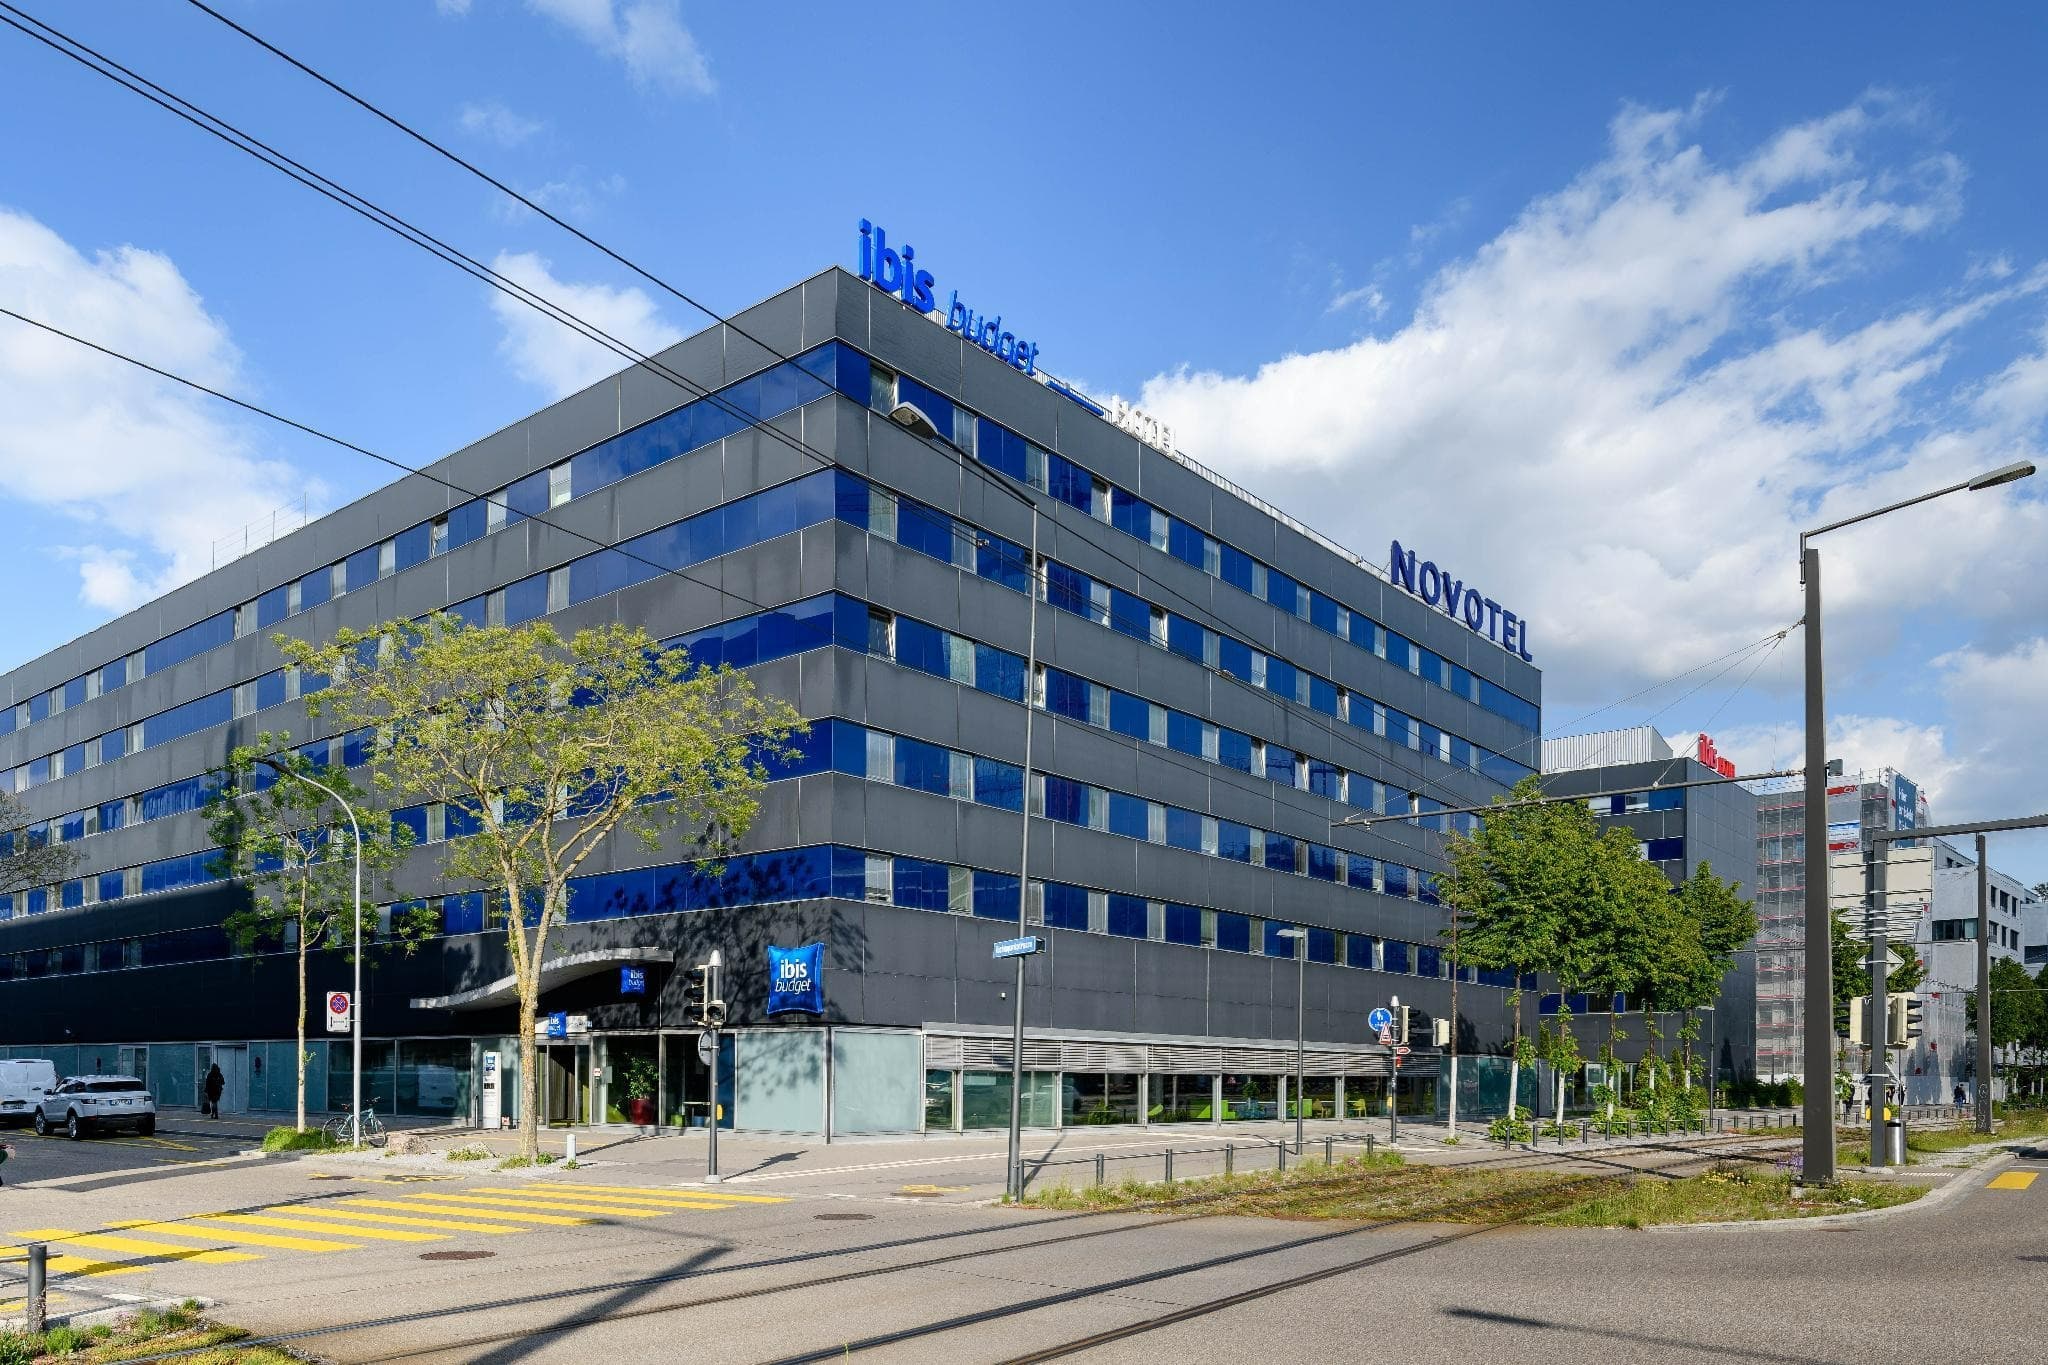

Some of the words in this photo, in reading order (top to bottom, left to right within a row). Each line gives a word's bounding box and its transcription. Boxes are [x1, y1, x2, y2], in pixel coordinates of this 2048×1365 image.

[858, 217, 935, 314] ibis
[946, 290, 1039, 376] budget
[1391, 540, 1532, 662] NOVOTEL
[775, 978, 812, 995] budget
[780, 959, 808, 979] ibis
